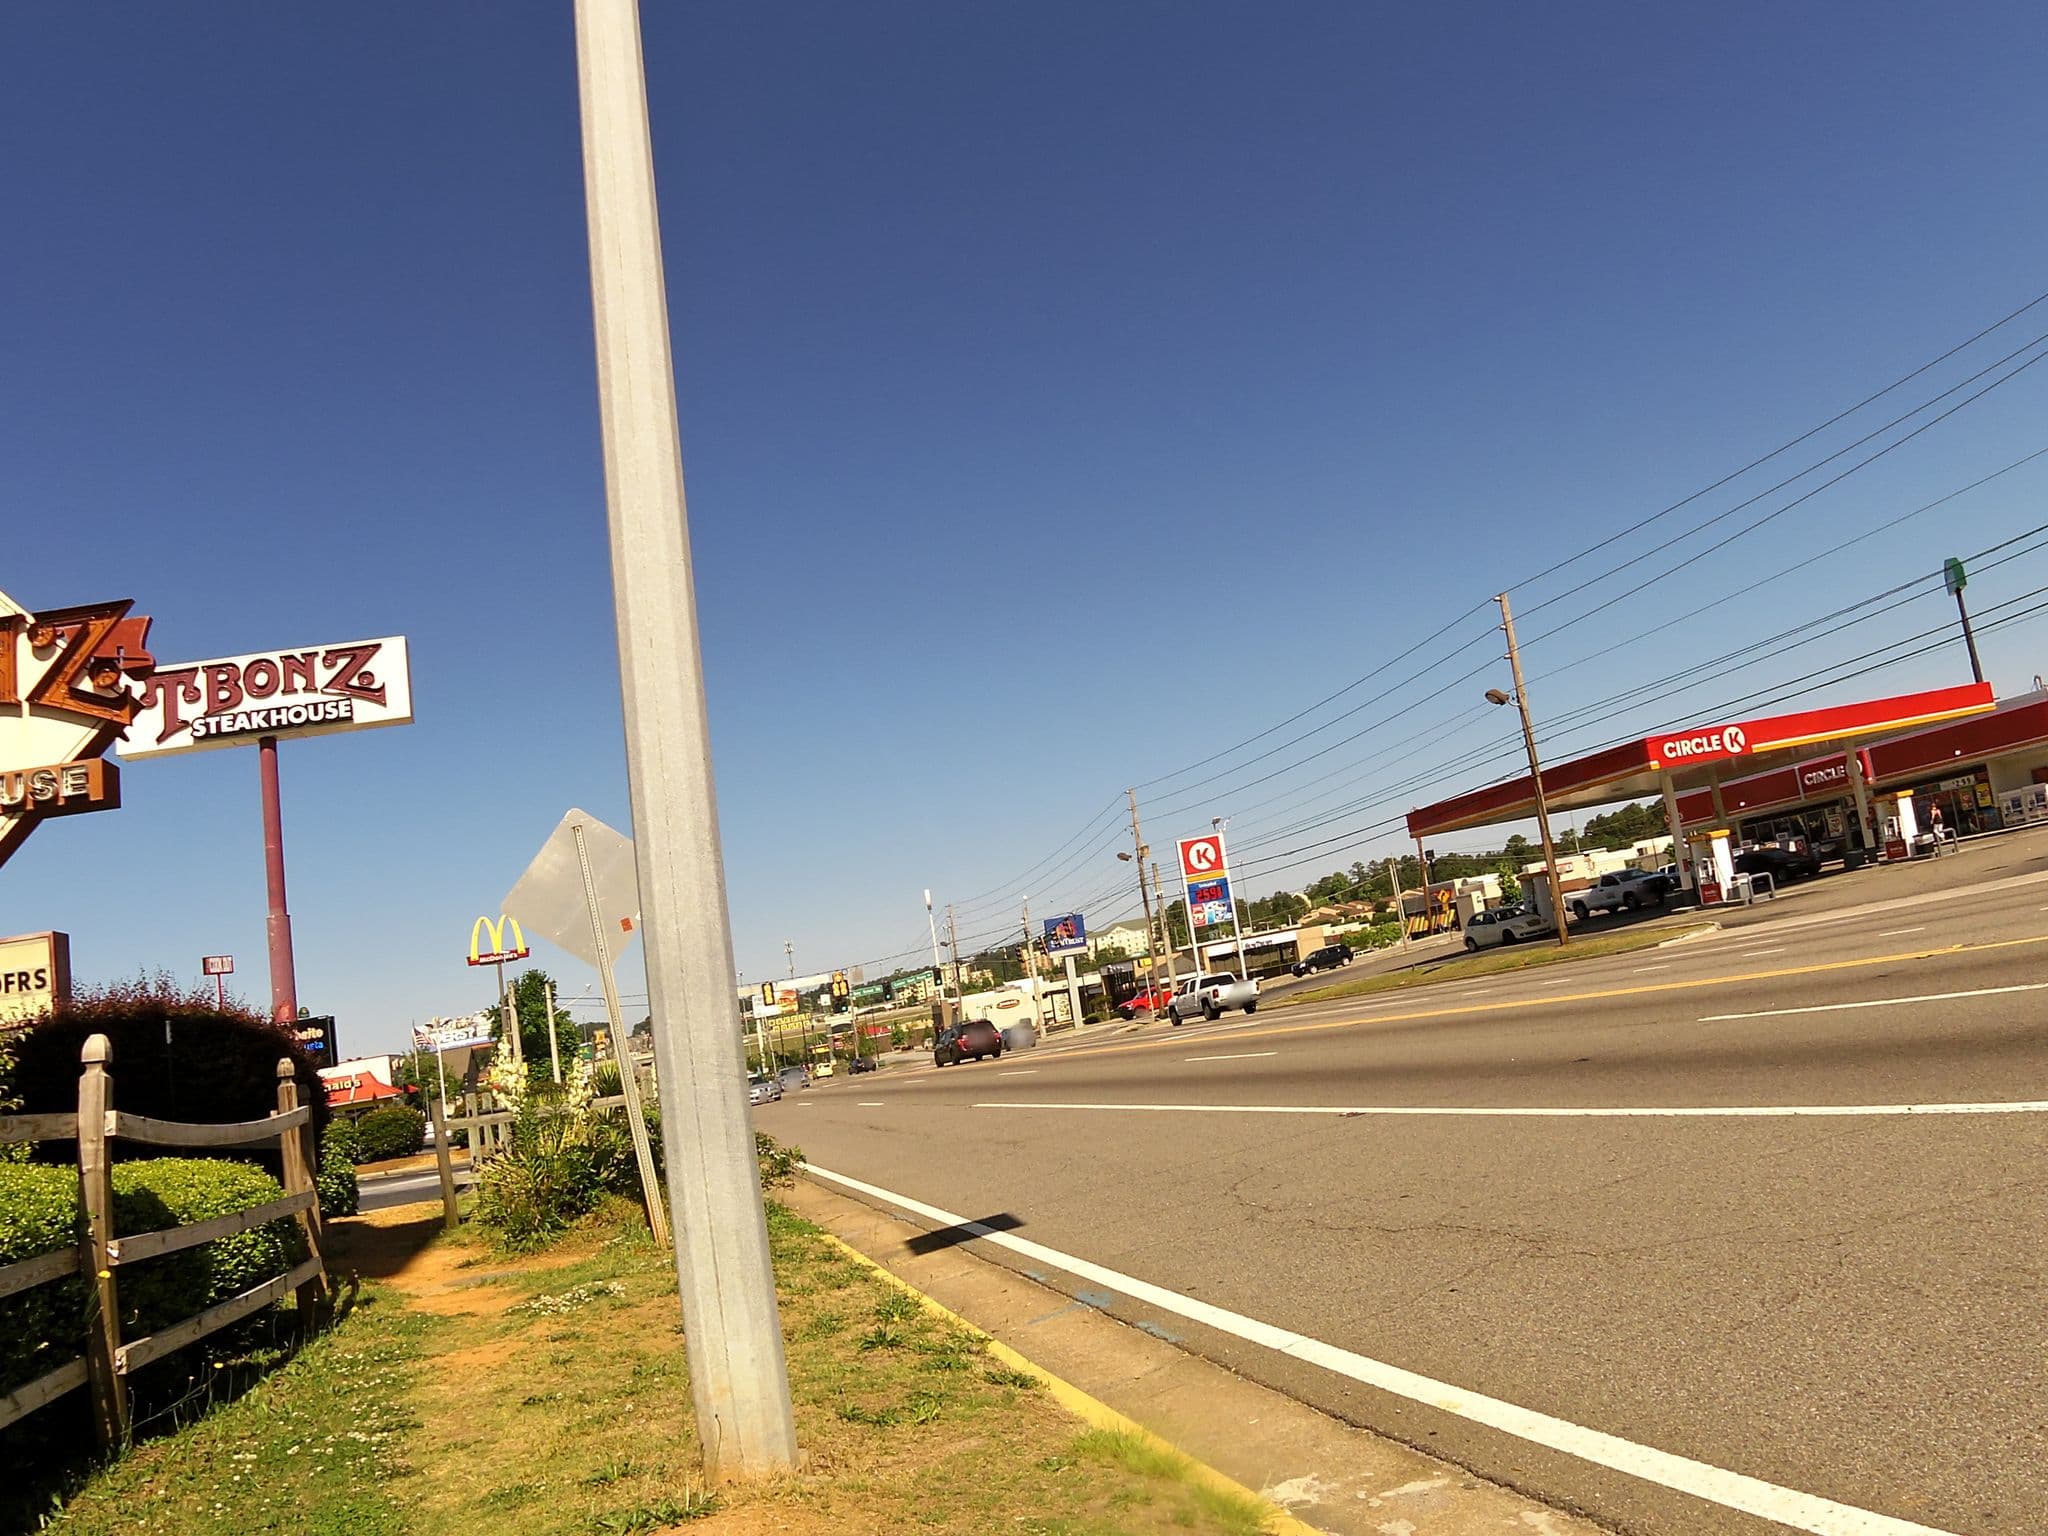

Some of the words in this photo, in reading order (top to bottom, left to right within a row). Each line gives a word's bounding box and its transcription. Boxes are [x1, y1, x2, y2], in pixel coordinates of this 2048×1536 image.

[191, 698, 353, 738] STEAKHOUSE
[1663, 734, 1722, 759] CIRCLE
[1725, 728, 1745, 751] K
[1803, 764, 1846, 786] CIRCLE
[0, 968, 47, 994] FRS
